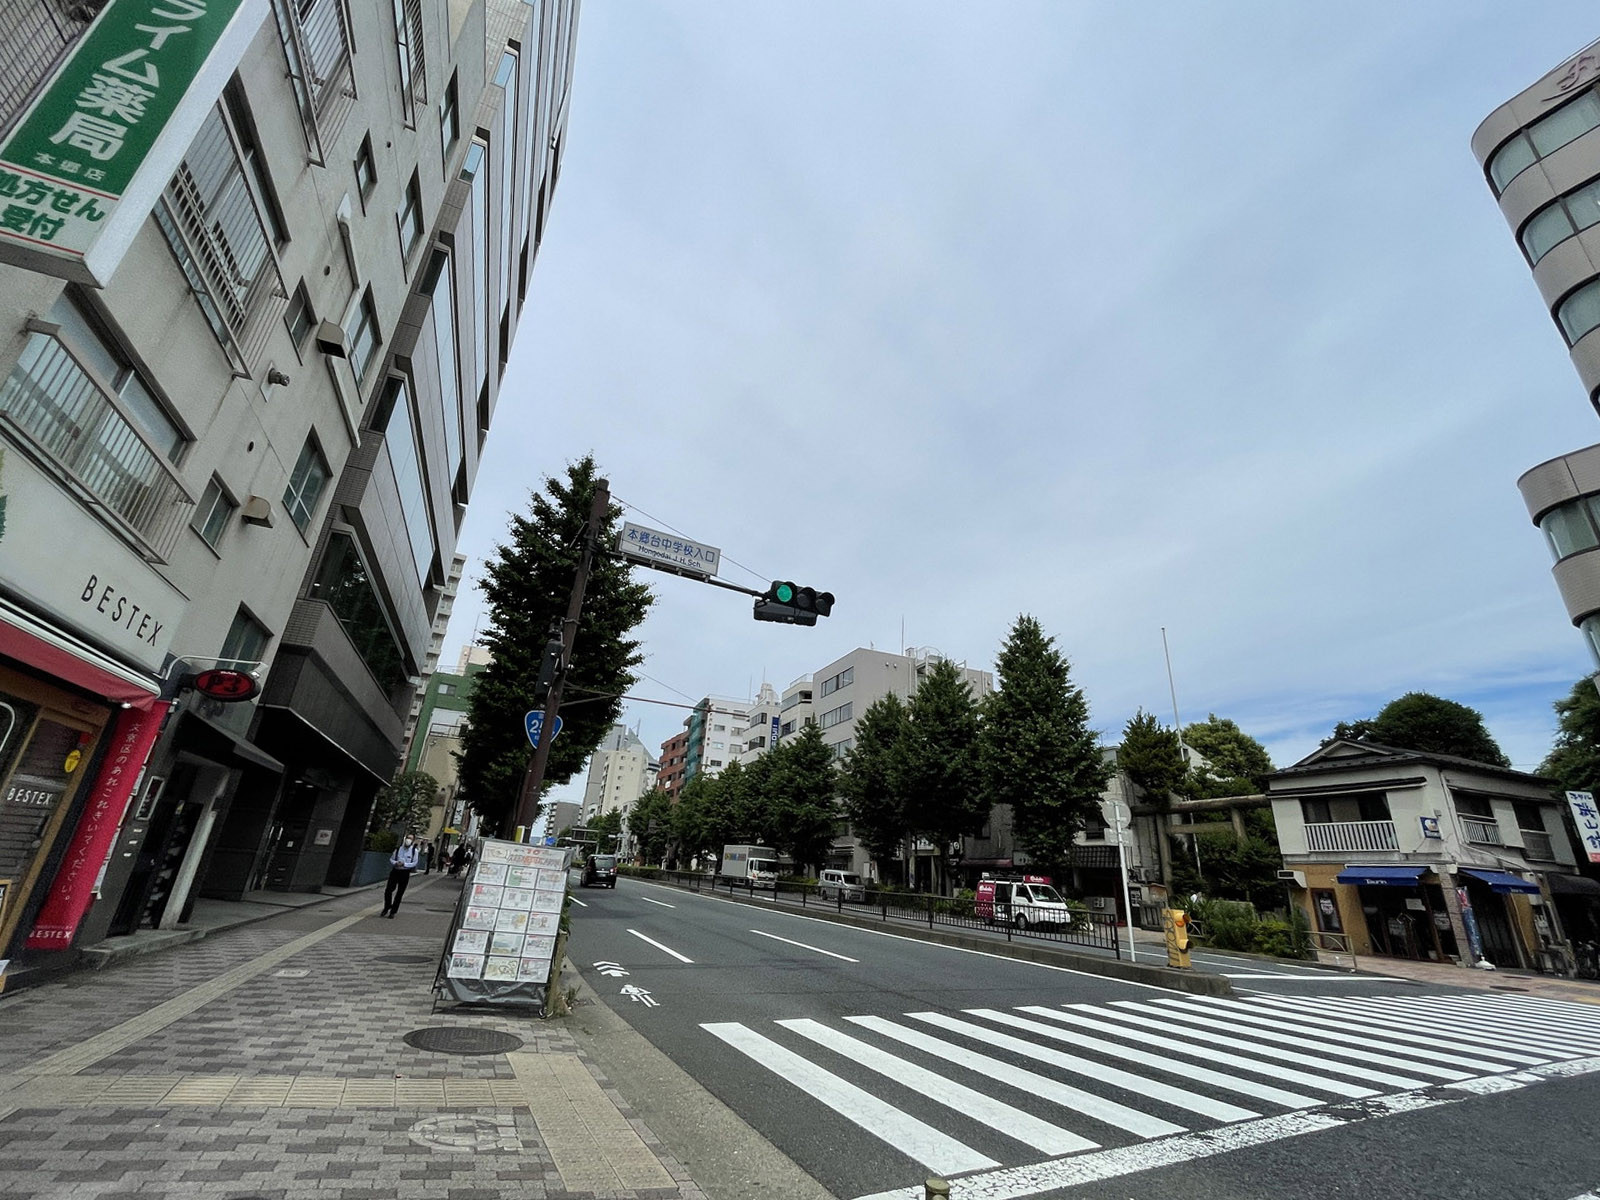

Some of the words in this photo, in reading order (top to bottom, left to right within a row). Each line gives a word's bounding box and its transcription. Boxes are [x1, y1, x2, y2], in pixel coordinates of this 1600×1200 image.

[0, 203, 66, 241] 受付
[628, 528, 715, 563] 本郷台中学校入口
[81, 574, 163, 647] BESTEX
[7, 787, 53, 805] BESTEX
